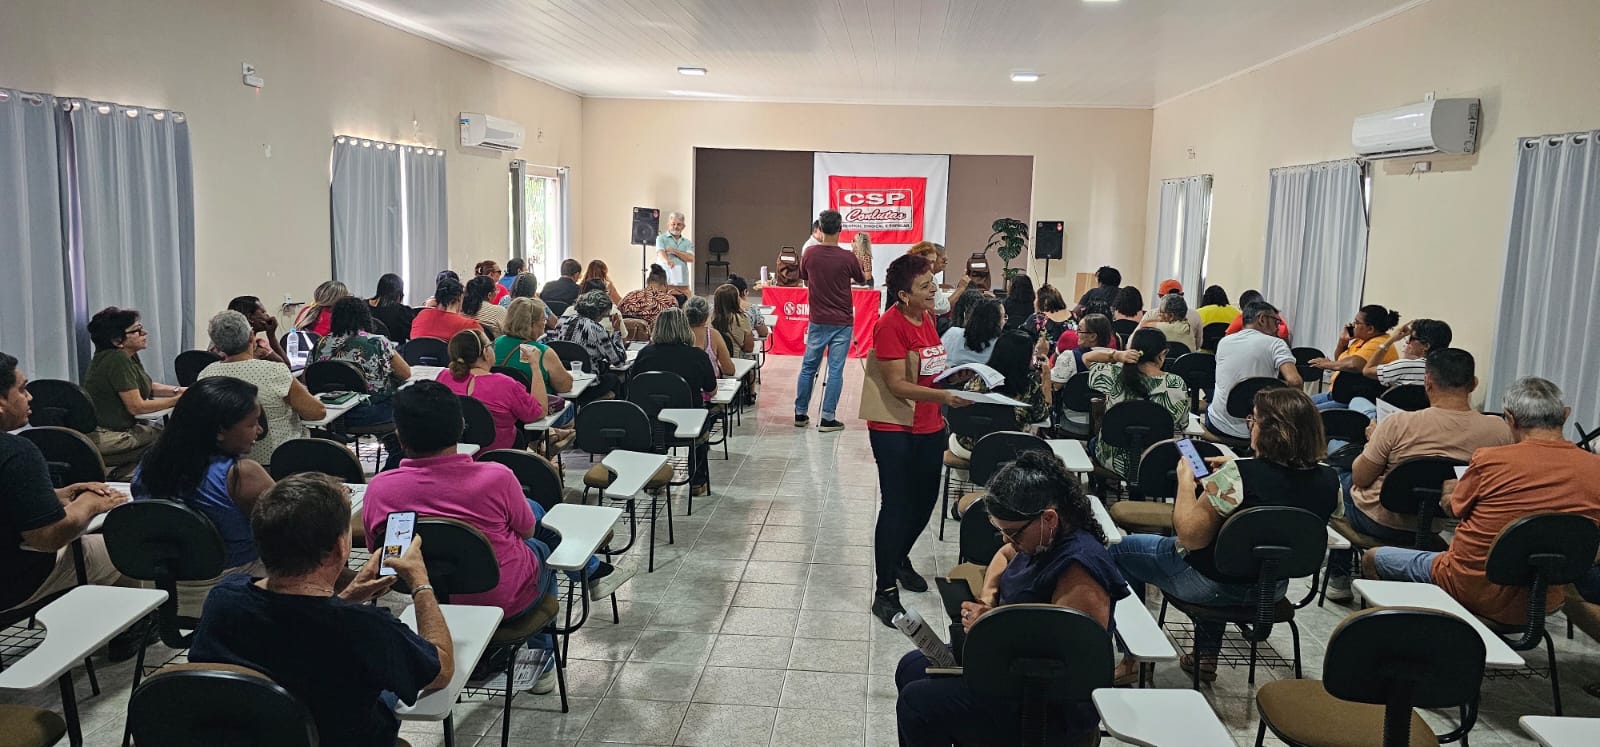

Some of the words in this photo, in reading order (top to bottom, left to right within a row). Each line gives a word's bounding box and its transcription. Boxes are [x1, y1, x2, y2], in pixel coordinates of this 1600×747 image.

[844, 193, 906, 206] CSP
[846, 209, 906, 222] Conlutas
[922, 345, 945, 358] CSP
